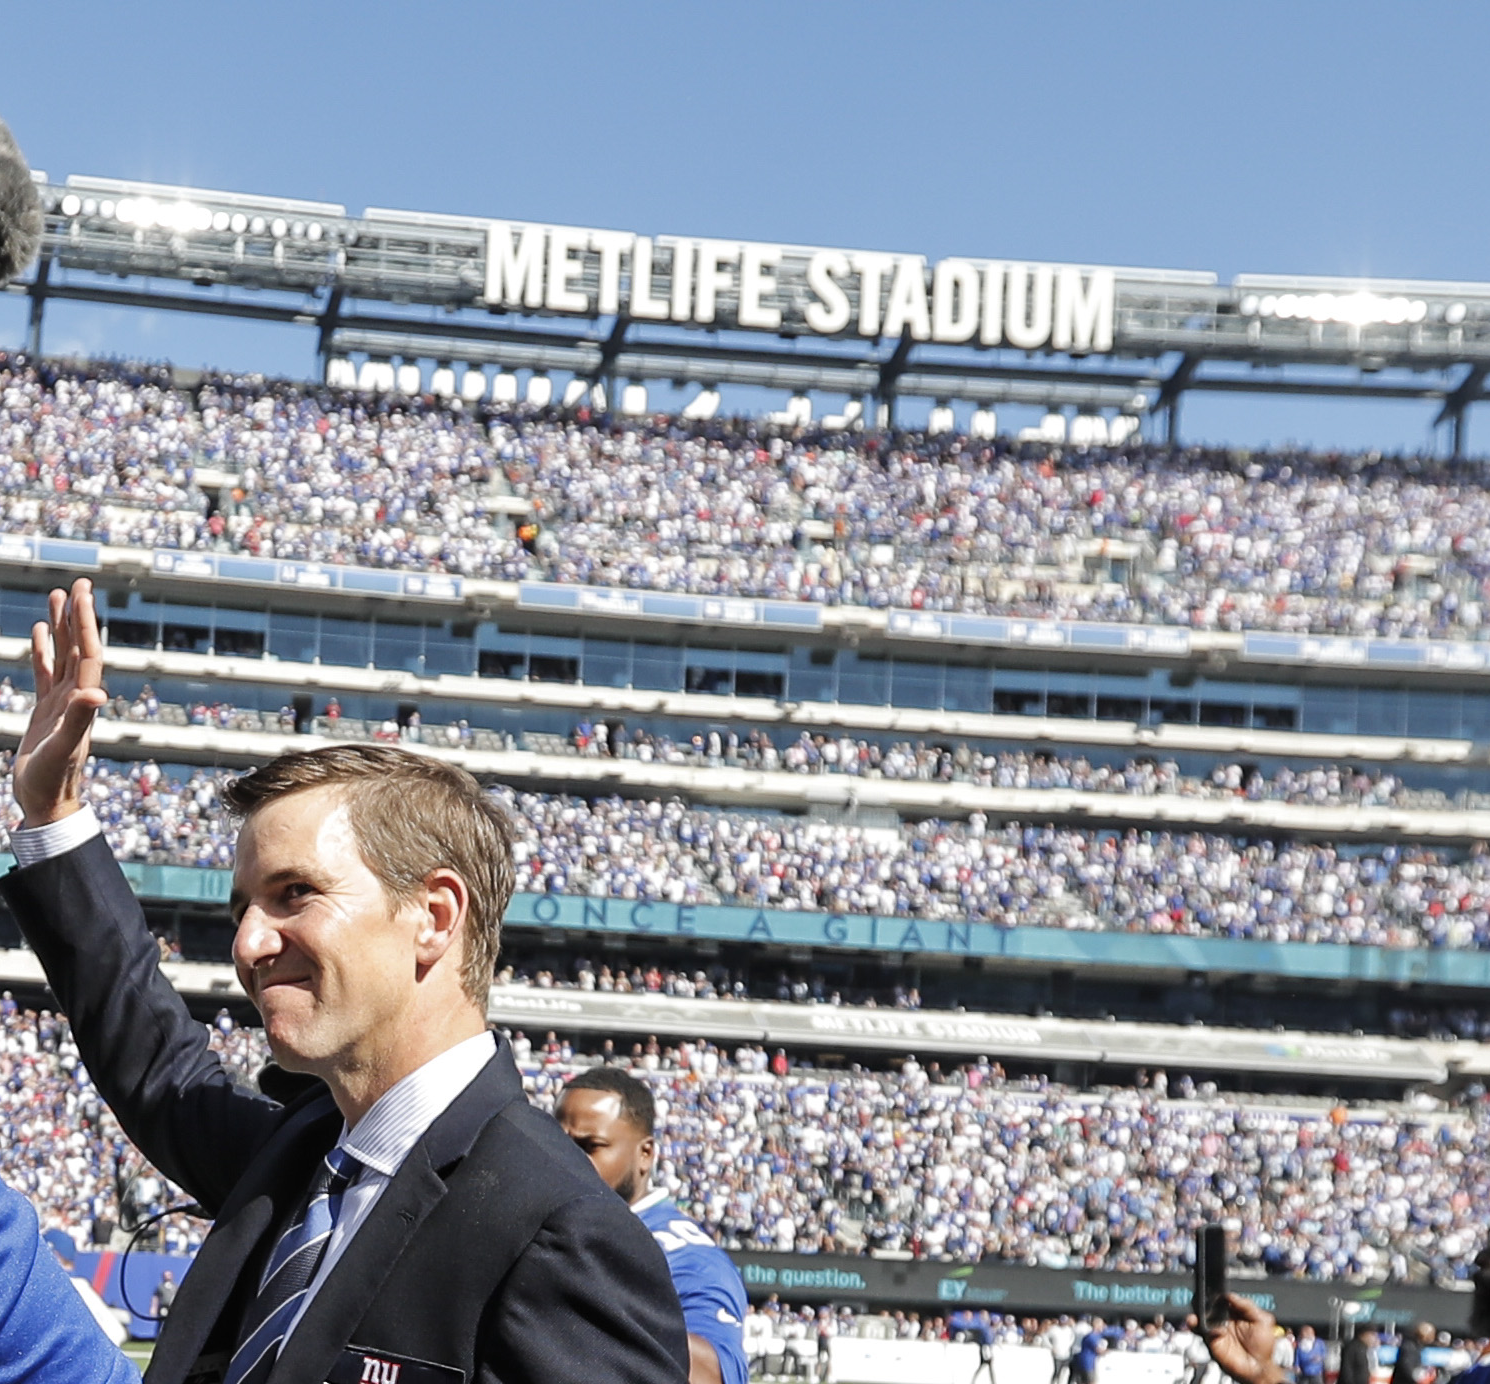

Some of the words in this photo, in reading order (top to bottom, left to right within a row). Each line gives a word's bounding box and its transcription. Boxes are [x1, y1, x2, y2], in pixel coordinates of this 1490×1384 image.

[482, 223, 783, 328] METLIFE
[805, 248, 1115, 352] STADIUM
[531, 894, 699, 936] ONCE
[746, 912, 792, 941] A
[823, 913, 1017, 954] GIANT
[744, 1264, 777, 1282] the
[781, 1267, 867, 1290] question.
[1072, 1281, 1108, 1302] The
[1110, 1283, 1170, 1304] better
